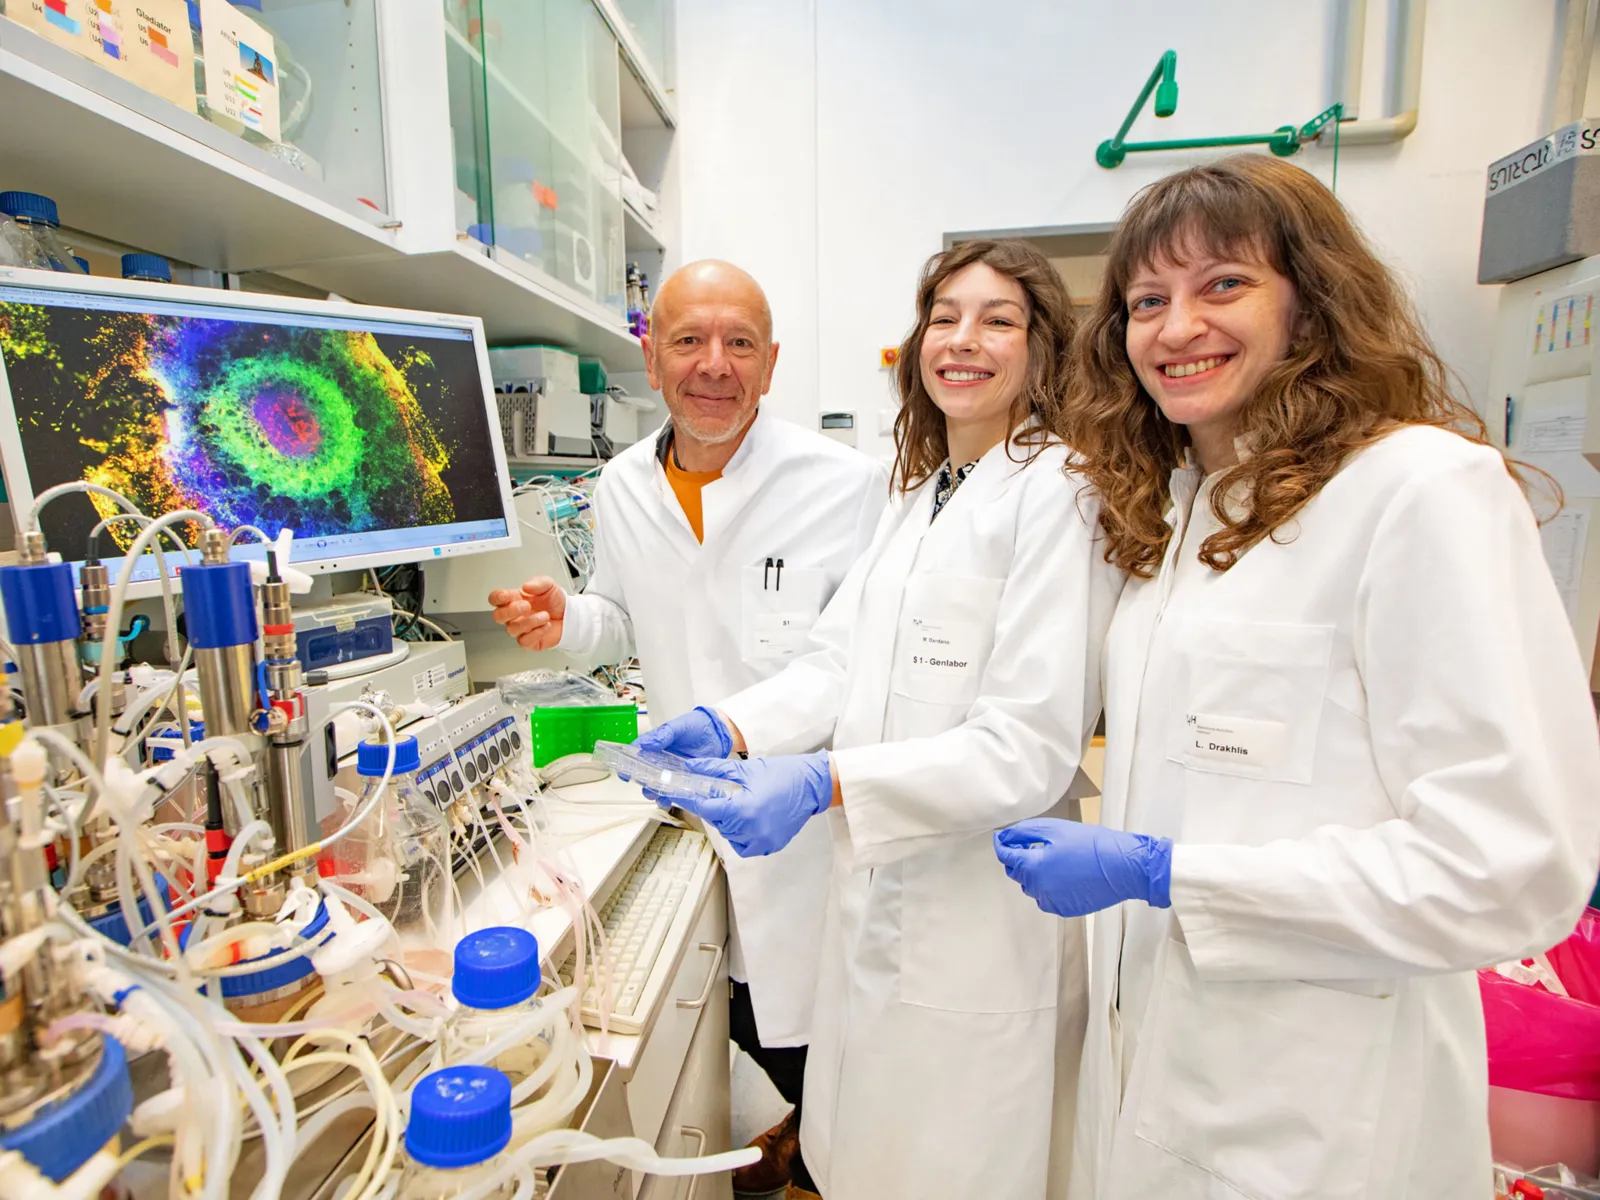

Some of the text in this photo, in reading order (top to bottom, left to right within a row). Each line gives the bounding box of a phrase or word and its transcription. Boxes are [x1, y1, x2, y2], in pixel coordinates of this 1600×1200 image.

[135, 7, 172, 34] Gladiator
[929, 657, 967, 668] Genlabor
[1195, 740, 1249, 756] L. Drakhlis
